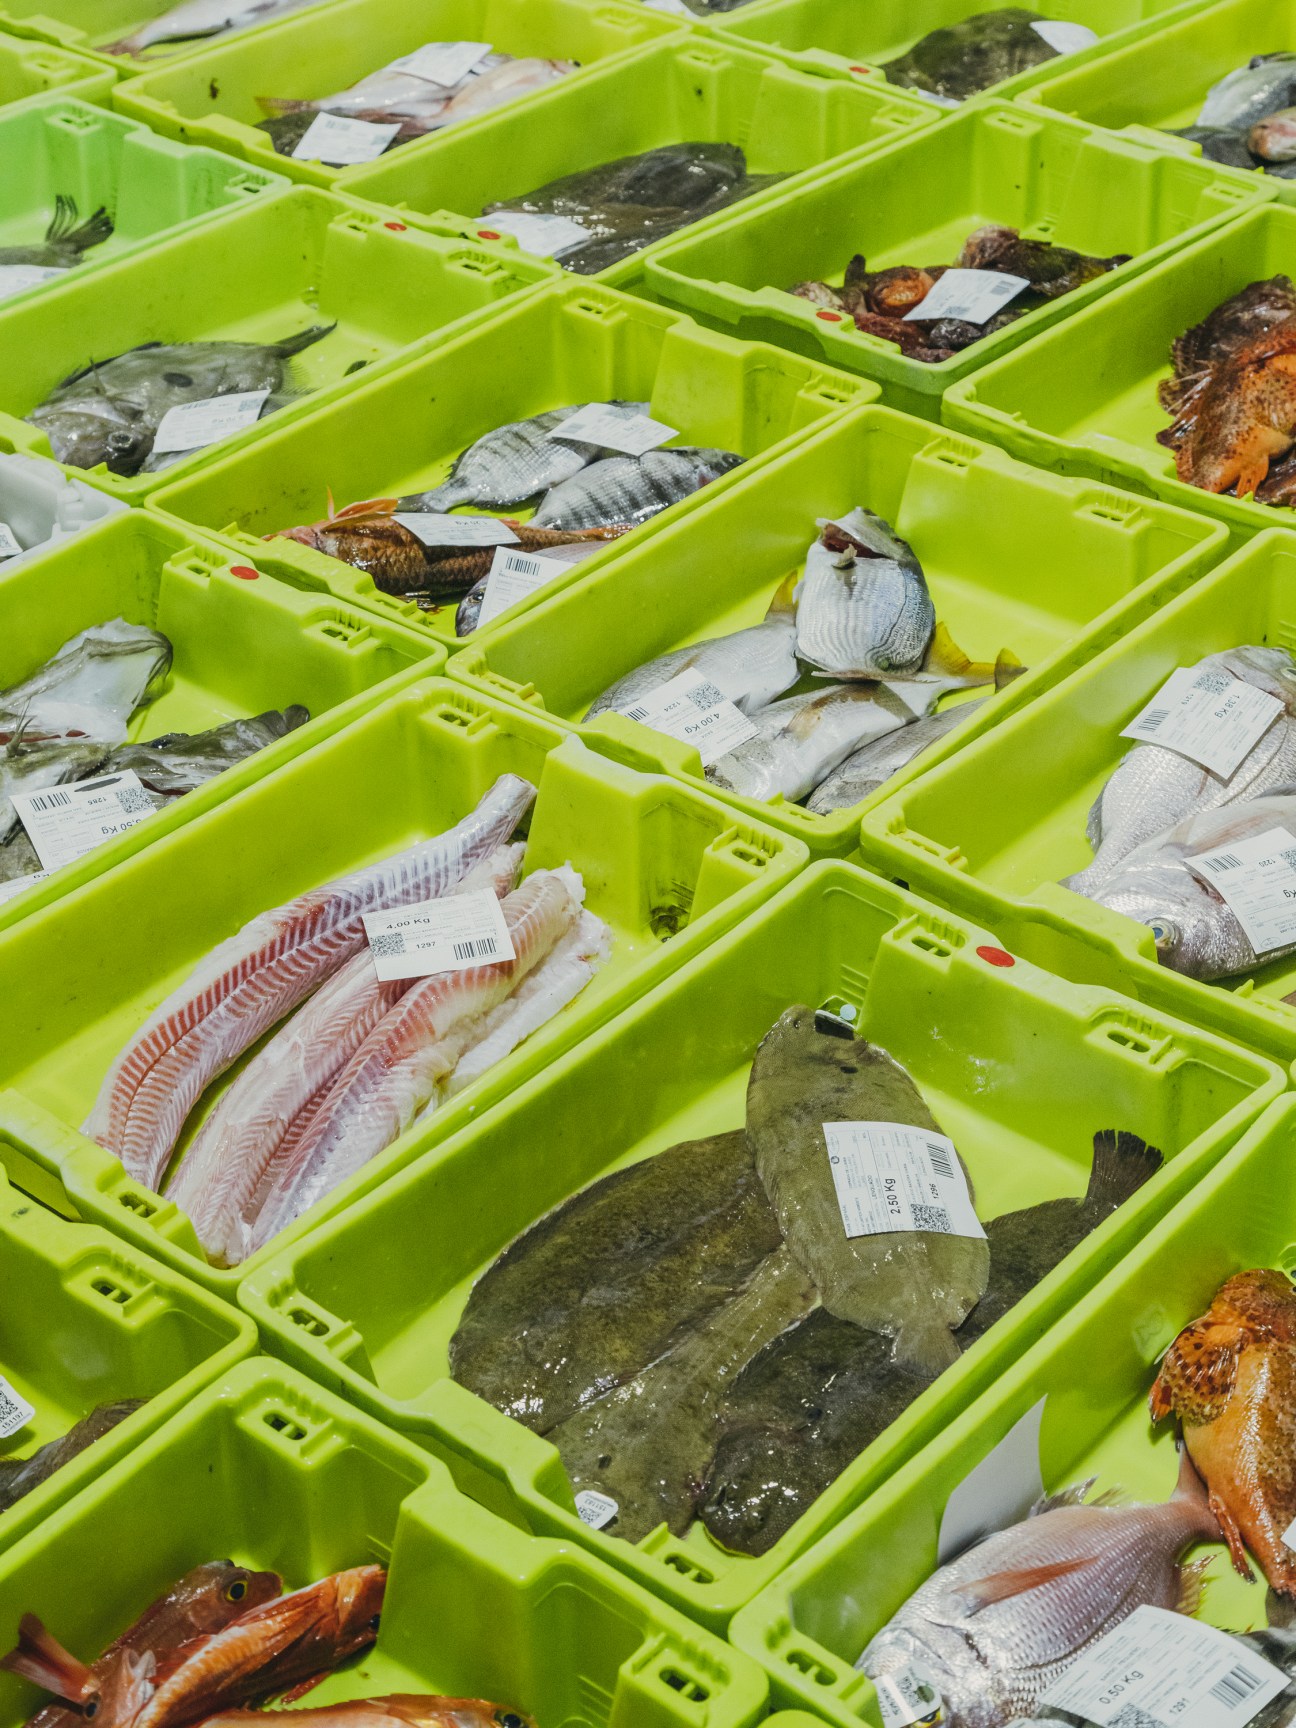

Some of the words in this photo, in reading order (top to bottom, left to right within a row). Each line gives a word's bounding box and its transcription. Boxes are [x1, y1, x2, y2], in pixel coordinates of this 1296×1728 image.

[663, 701, 681, 712] 1224
[1213, 707, 1230, 718] Kg
[684, 723, 701, 734] Kg
[101, 825, 119, 835] Kg
[413, 917, 431, 925] Kg
[416, 941, 436, 949] 1297
[883, 1178, 896, 1192] Kg
[928, 1183, 940, 1199] 1296
[886, 1194, 902, 1215] 2,50
[1121, 1670, 1144, 1685] Kg
[1169, 1697, 1191, 1714] 1291
